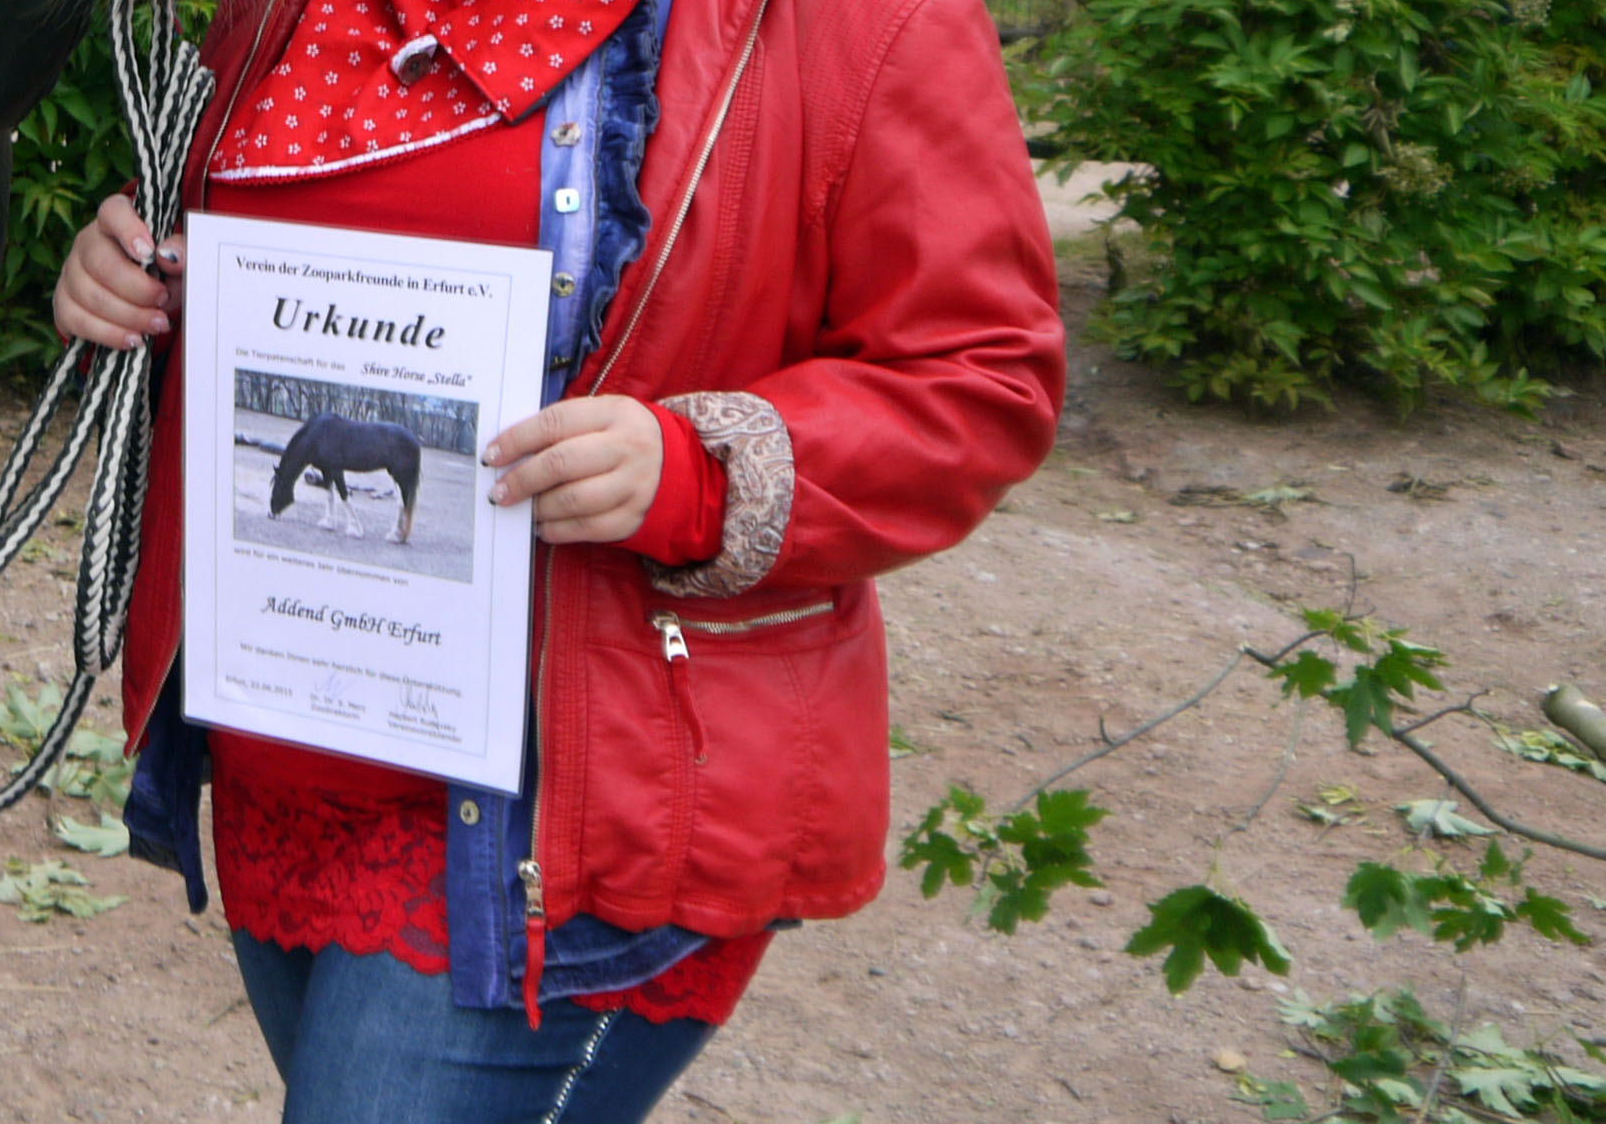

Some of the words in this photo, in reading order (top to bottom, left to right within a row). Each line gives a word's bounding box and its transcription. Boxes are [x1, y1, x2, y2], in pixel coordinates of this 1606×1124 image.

[235, 255, 276, 274] Verein
[278, 262, 300, 277] der
[301, 263, 405, 289] Zooparkfreunde
[407, 275, 420, 290] in
[423, 277, 465, 296] Erfurt
[467, 283, 493, 299] e.V.
[272, 296, 447, 350] Urkunde
[361, 361, 391, 377] Shire
[391, 365, 427, 382] Horse
[261, 595, 329, 622] Addend
[330, 609, 387, 633] GmbH
[387, 620, 443, 646] Erfurt
